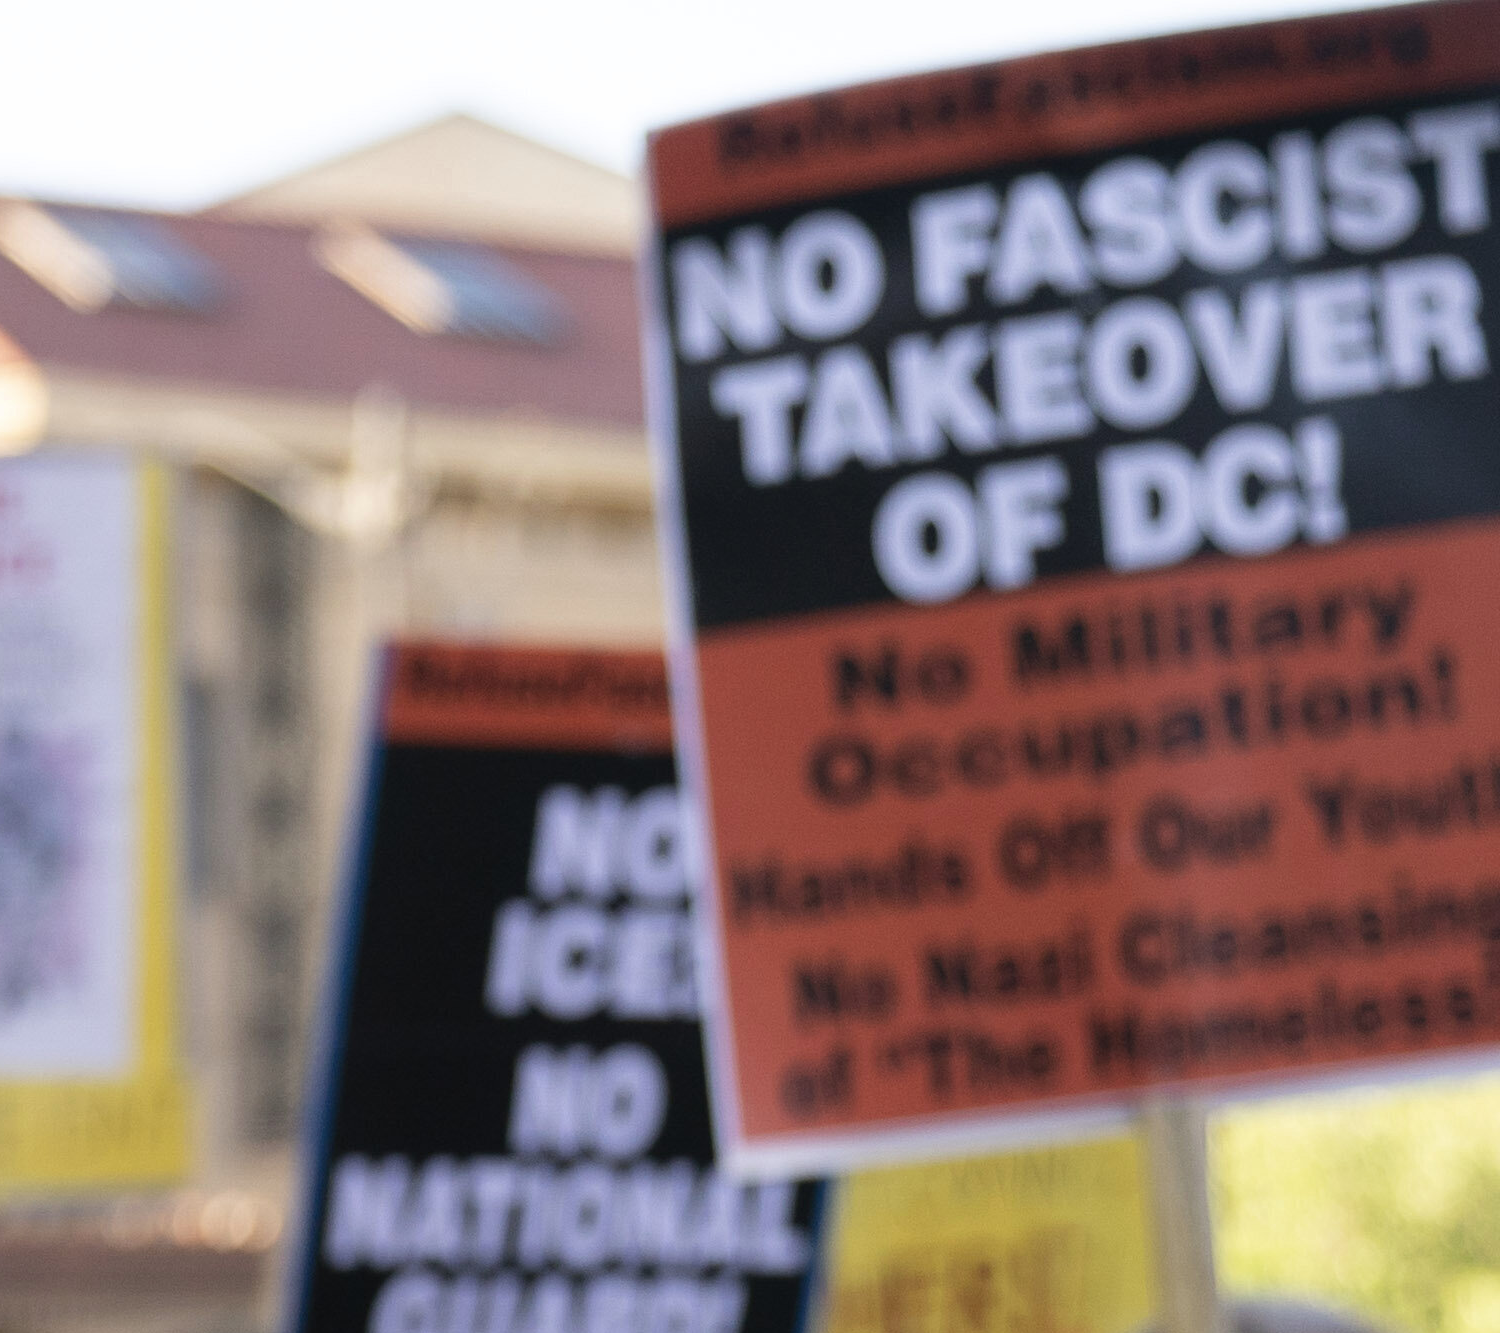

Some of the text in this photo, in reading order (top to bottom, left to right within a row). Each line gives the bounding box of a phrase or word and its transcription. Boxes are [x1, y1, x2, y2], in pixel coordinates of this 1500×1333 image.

[673, 98, 1500, 364] NO FASCIST
[711, 255, 1486, 487] TAKEOVER
[874, 417, 1347, 600] OF DC!
[834, 574, 1420, 712] No Military
[811, 651, 1457, 801] Occupation!
[527, 780, 692, 900] NO
[736, 829, 966, 918] Hands
[1003, 806, 1106, 890] Off
[1141, 792, 1273, 867] Our
[486, 896, 700, 1021] ICE
[792, 956, 890, 1021] No
[509, 1042, 668, 1157] NO
[324, 1154, 814, 1274] NATIONAL
